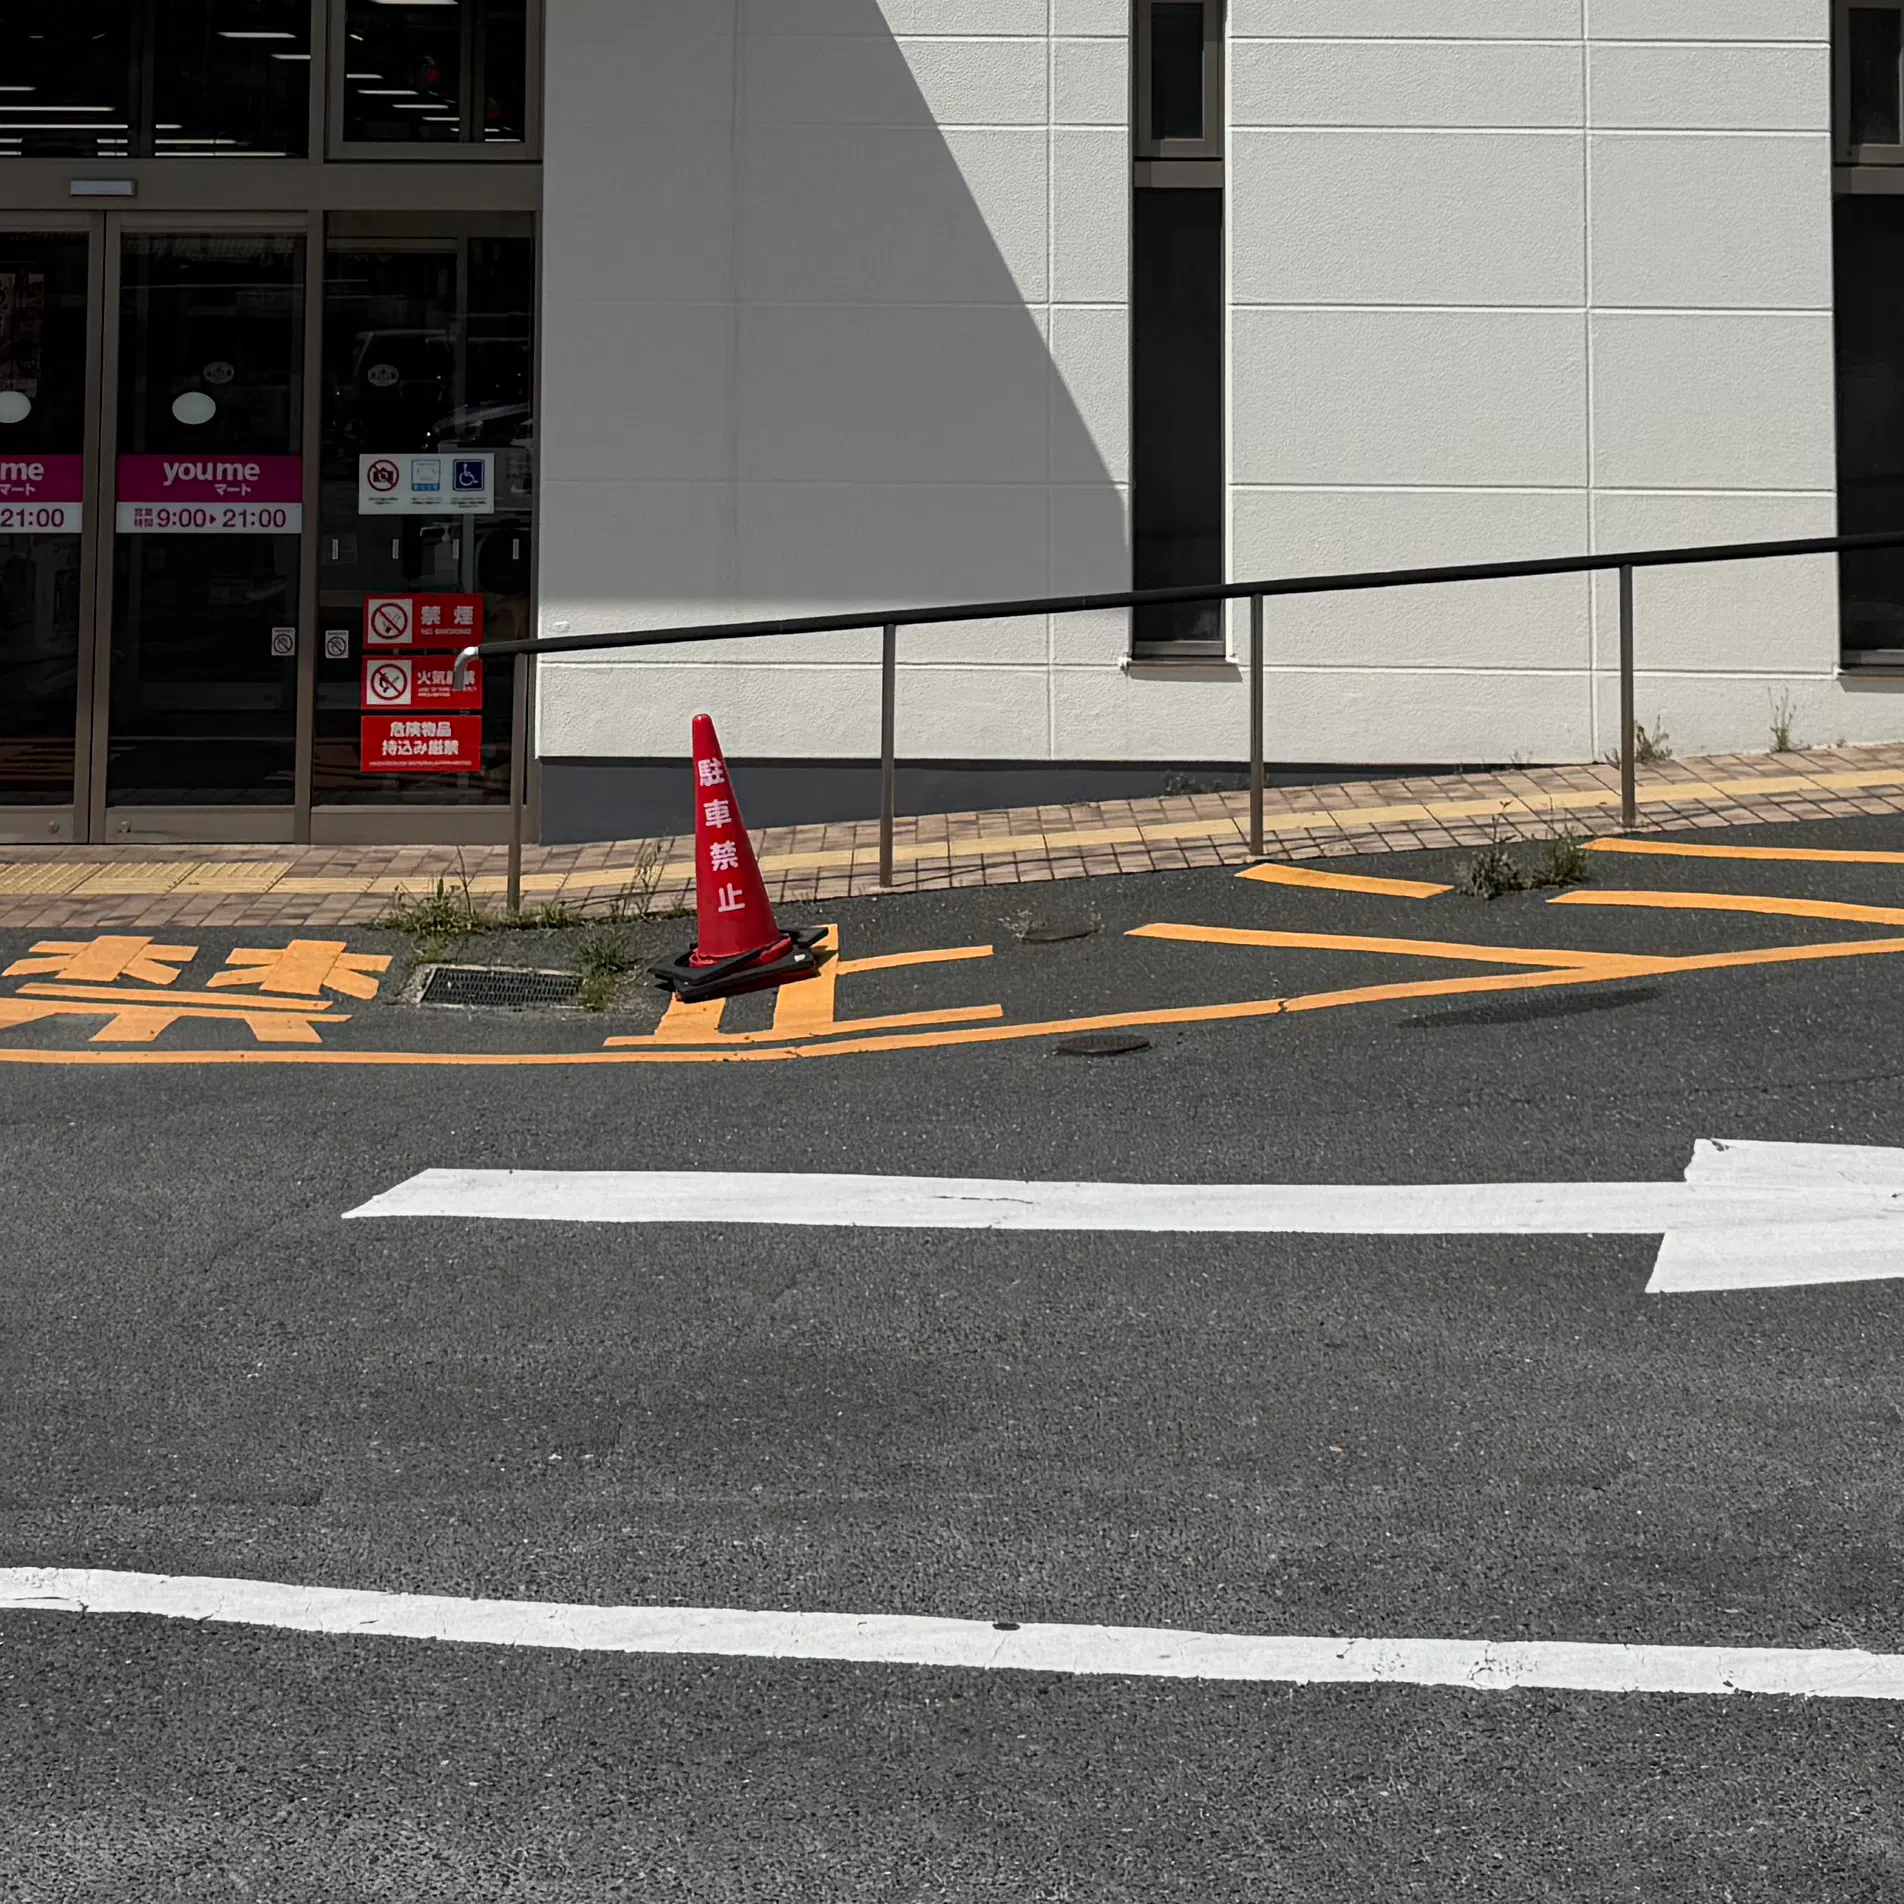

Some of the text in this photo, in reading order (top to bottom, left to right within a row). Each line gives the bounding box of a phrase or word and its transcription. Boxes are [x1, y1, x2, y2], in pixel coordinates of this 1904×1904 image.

[162, 461, 260, 487] youme
[214, 483, 252, 495] マート
[696, 757, 746, 914] 駐車禁止
